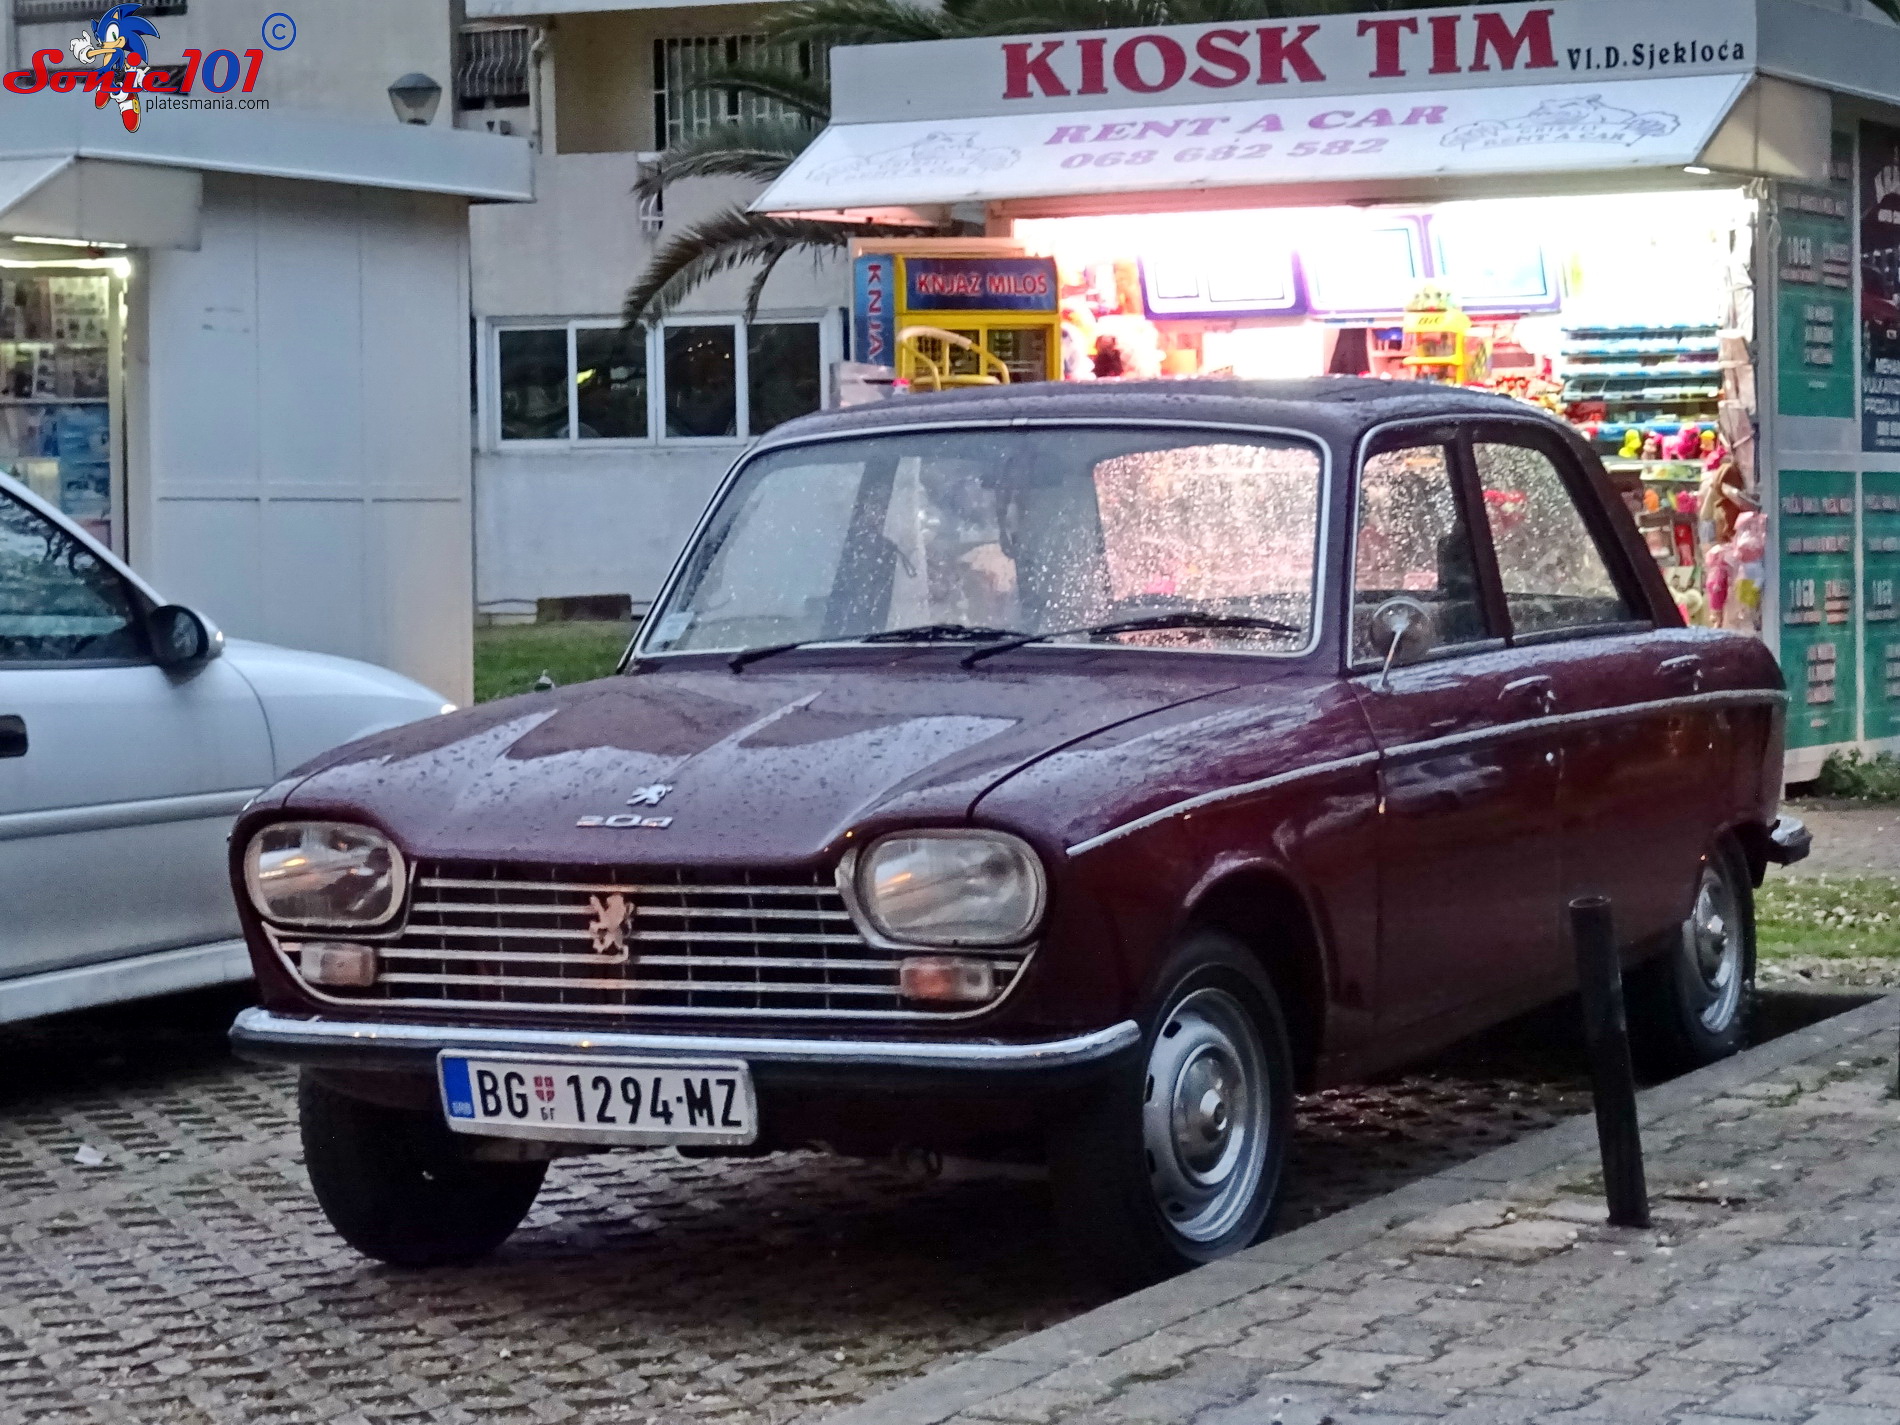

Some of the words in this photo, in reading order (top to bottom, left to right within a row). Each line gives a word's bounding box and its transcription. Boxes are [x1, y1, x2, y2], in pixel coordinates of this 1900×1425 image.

[1002, 24, 1326, 100] KIOSK
[1357, 9, 1558, 78] TIM
[1044, 117, 1230, 145] RENT
[1236, 113, 1284, 133] A
[1307, 105, 1448, 130] CAR
[1060, 150, 1159, 168] 068
[1173, 143, 1273, 162] 682
[1287, 138, 1389, 157] 582
[916, 273, 980, 294] KNJAZ
[476, 1069, 529, 1119] BG
